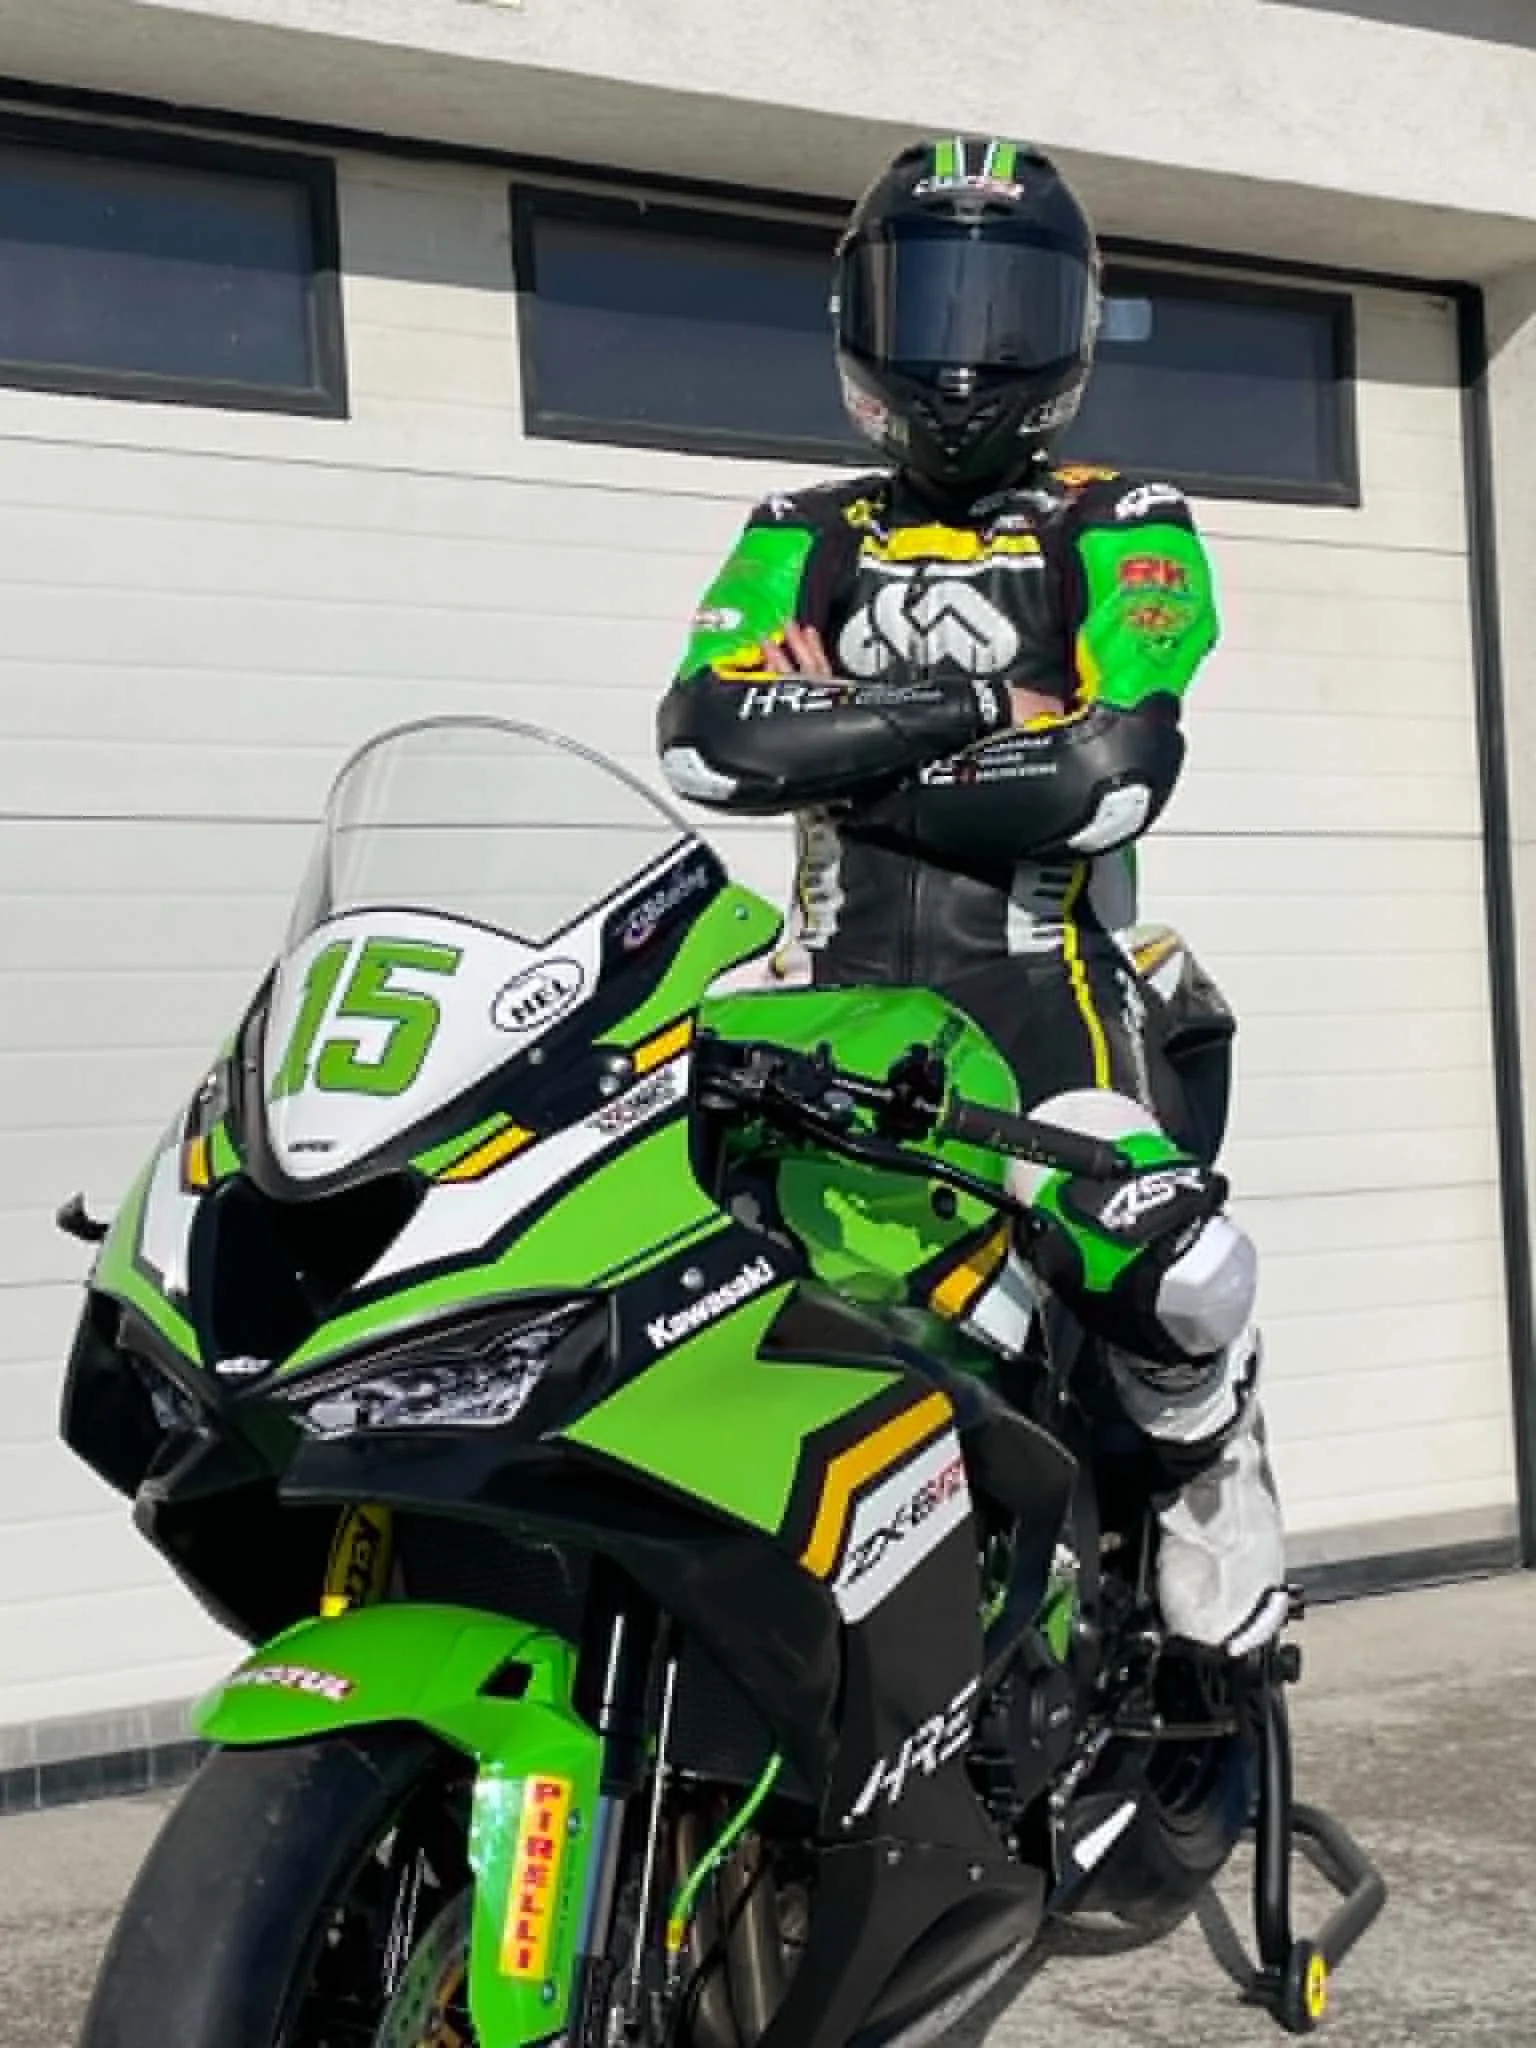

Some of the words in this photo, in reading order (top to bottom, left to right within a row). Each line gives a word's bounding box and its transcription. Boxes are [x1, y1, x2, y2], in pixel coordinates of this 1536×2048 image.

[271, 936, 464, 1099] 15
[646, 1255, 776, 1350] Kawasaki
[517, 1782, 562, 1970] PIRELLI
